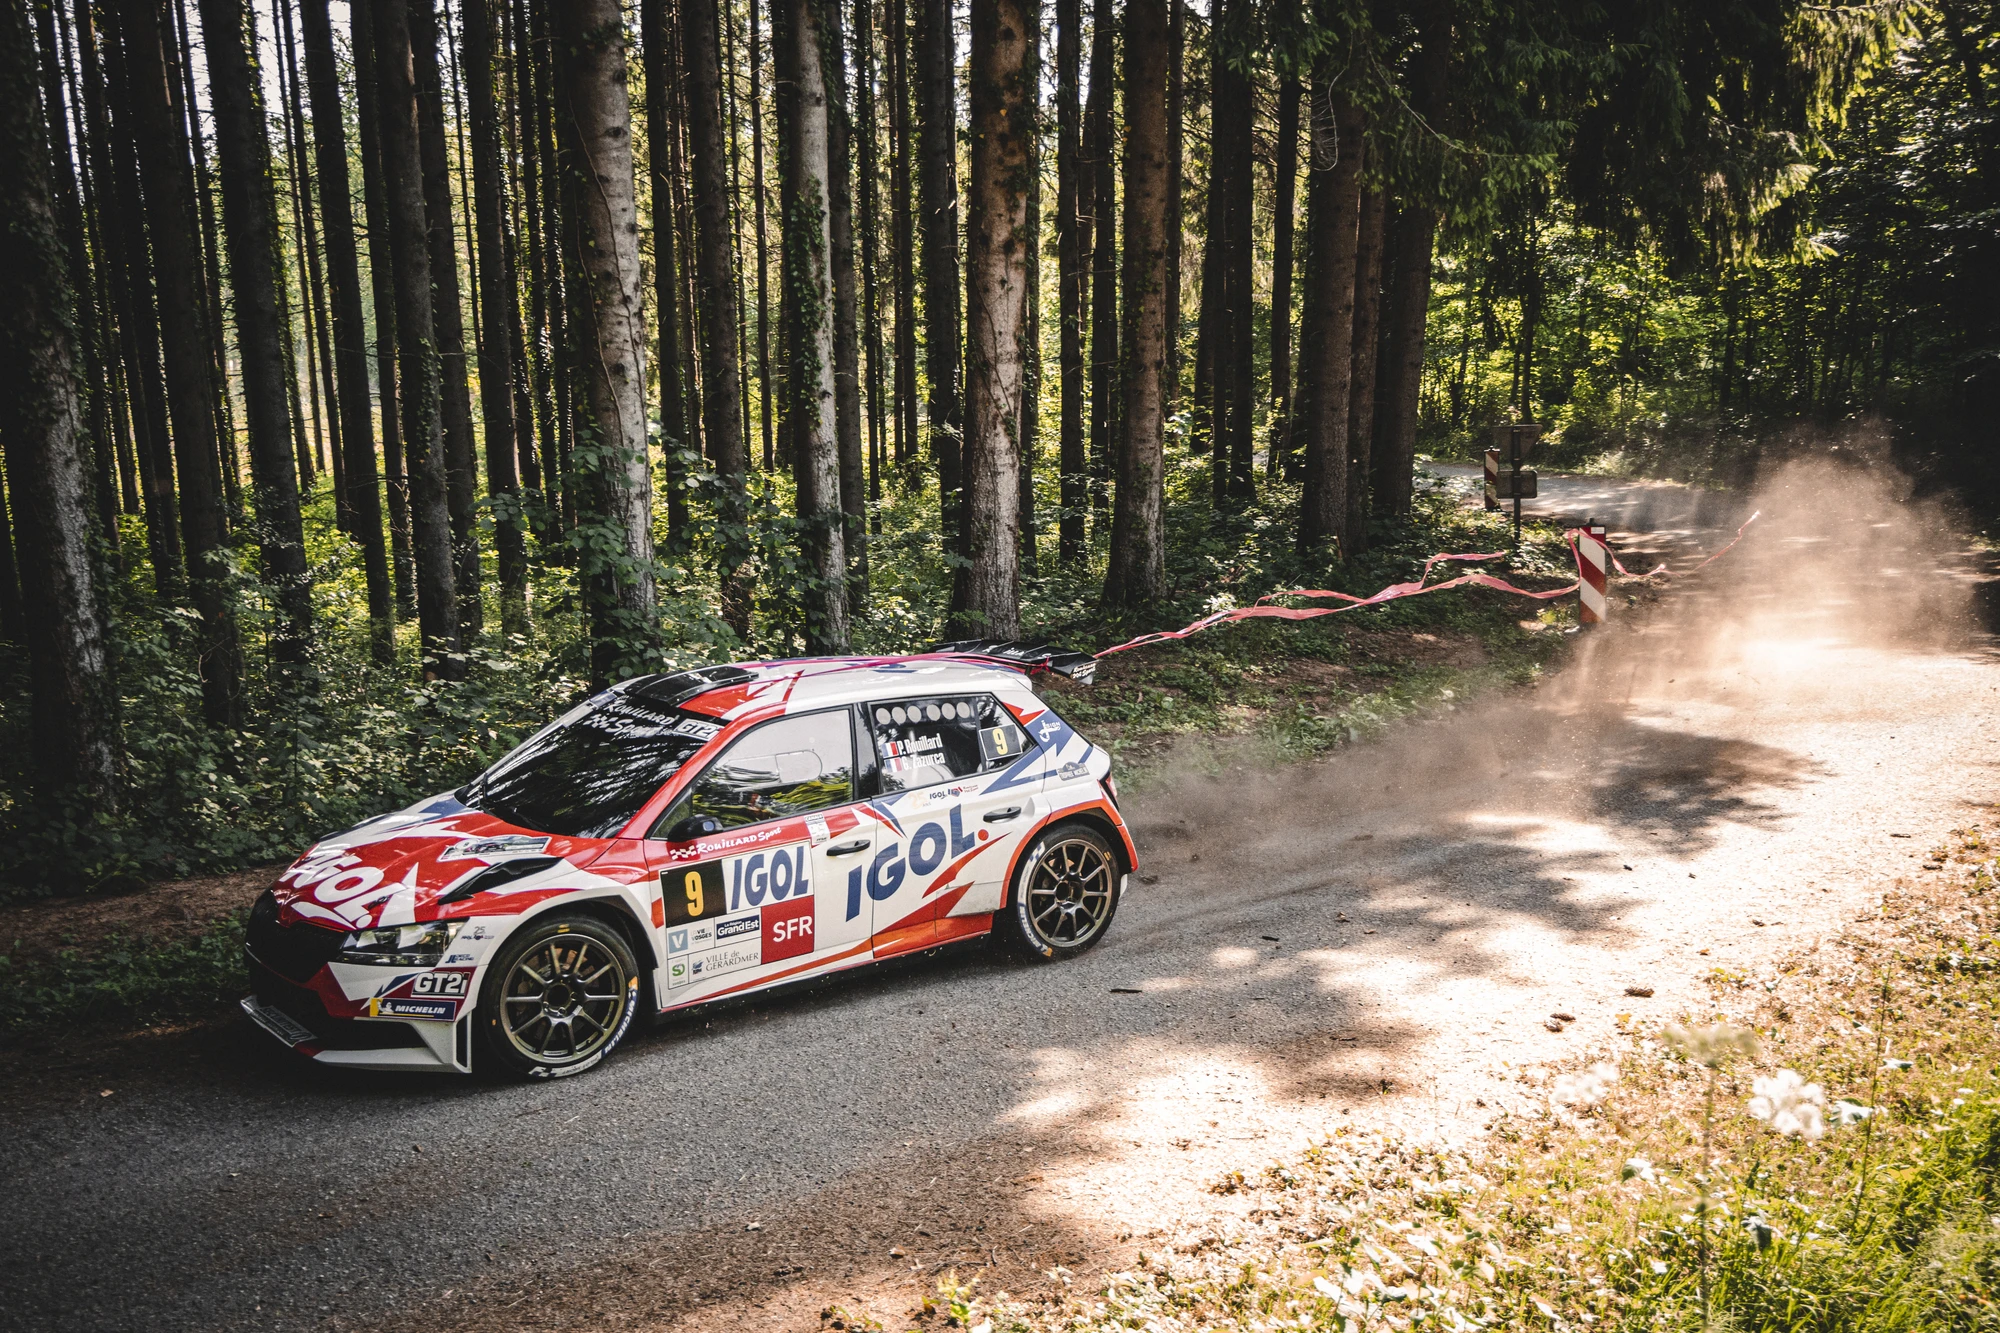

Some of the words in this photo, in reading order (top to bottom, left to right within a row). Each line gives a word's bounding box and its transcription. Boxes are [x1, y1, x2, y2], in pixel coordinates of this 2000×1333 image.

[897, 741, 906, 755] P.
[904, 733, 943, 754] Rouillard
[992, 729, 1008, 755] 9
[902, 756, 911, 770] G.
[910, 753, 946, 769] Zazurca
[757, 827, 781, 841] Sport
[731, 846, 809, 910] IGOL
[685, 871, 704, 917] 9
[474, 926, 486, 935] 25
[717, 922, 745, 936] Grand
[745, 919, 759, 930] Est
[773, 916, 813, 942] SFR
[706, 951, 728, 963] VILLE
[731, 950, 739, 958] de
[414, 972, 468, 994] GT2i
[395, 1005, 446, 1014] MICHELIN
[604, 1000, 636, 1054] MICHELIN
